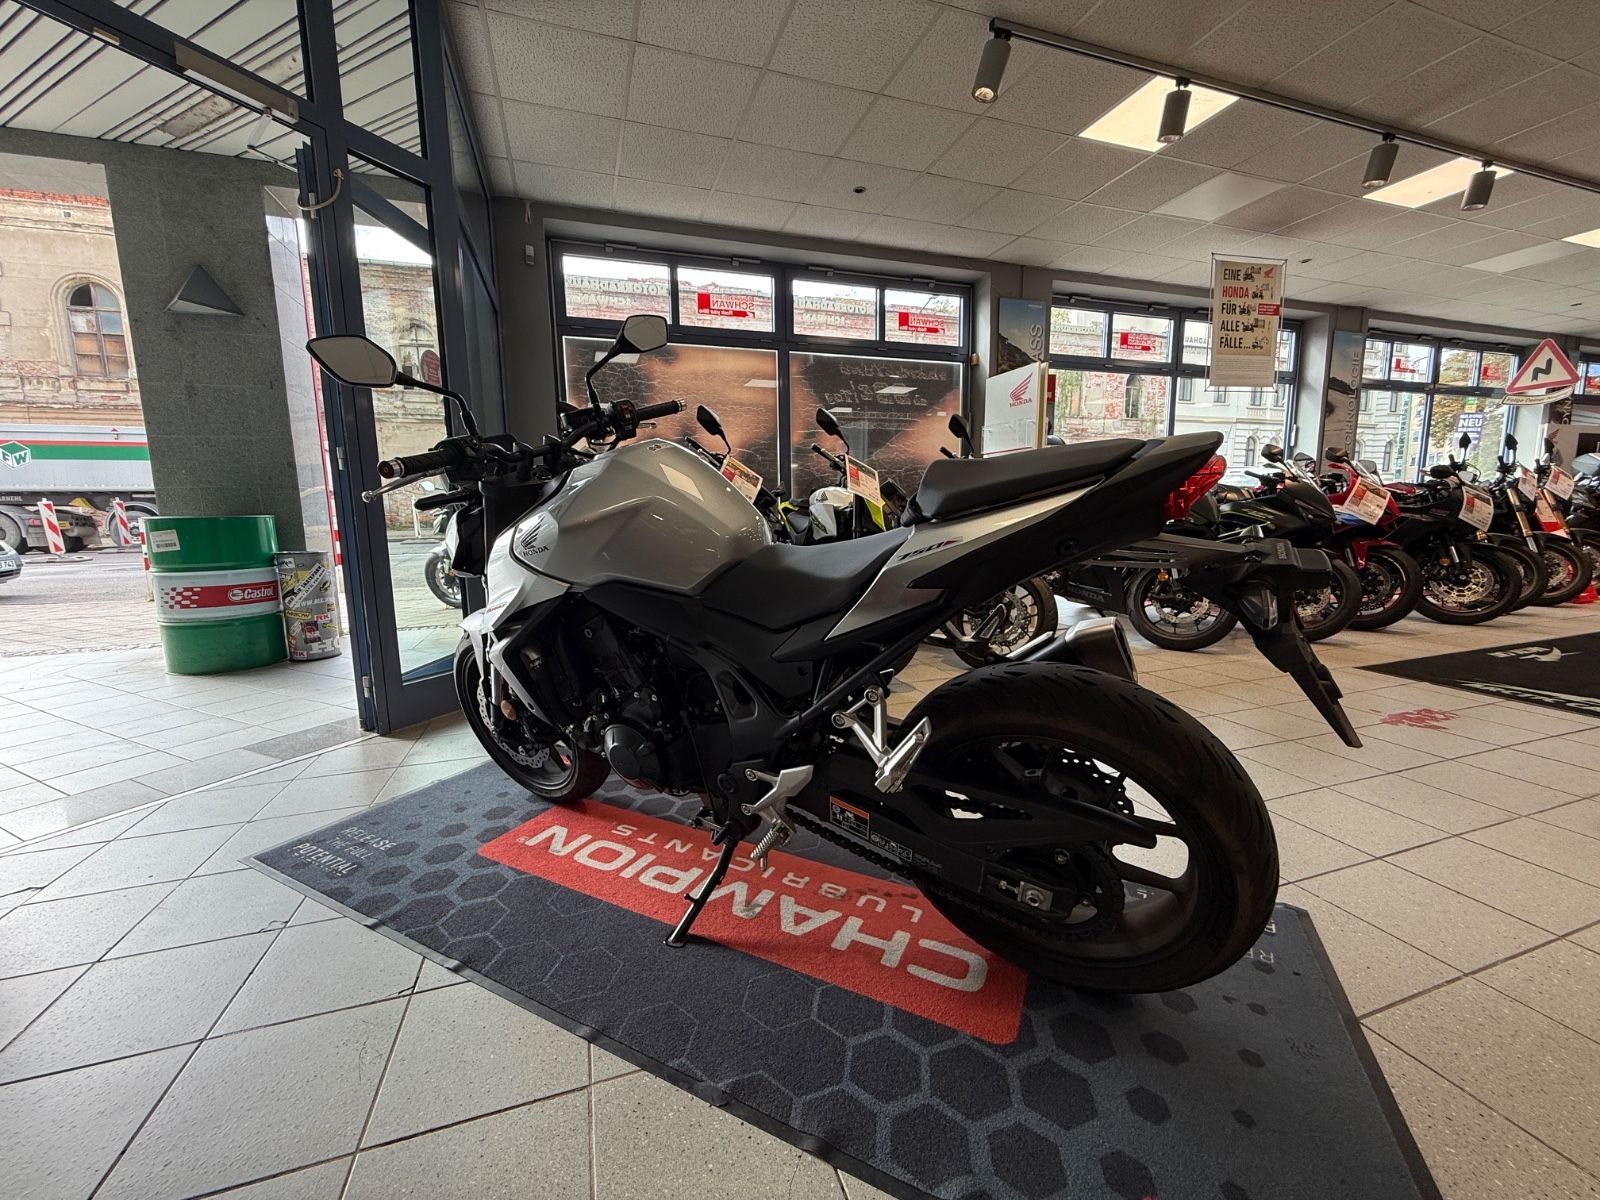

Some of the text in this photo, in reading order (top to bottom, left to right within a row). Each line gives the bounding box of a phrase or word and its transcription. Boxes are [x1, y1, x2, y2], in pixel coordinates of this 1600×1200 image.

[1223, 268, 1241, 281] EINE
[1222, 286, 1250, 299] HONDA
[1221, 300, 1237, 315] FÜR
[1220, 320, 1240, 332] ALLE
[1009, 398, 1032, 408] HONDA
[1458, 418, 1483, 427] NEU
[522, 545, 550, 557] HONDA
[243, 586, 274, 600] Castrol
[340, 826, 397, 851] RELEASE
[326, 837, 374, 860] THE FULL
[292, 842, 358, 874] POTENTIAL
[611, 823, 923, 923] LUBRICANTS
[526, 824, 988, 993] CHAMPION
